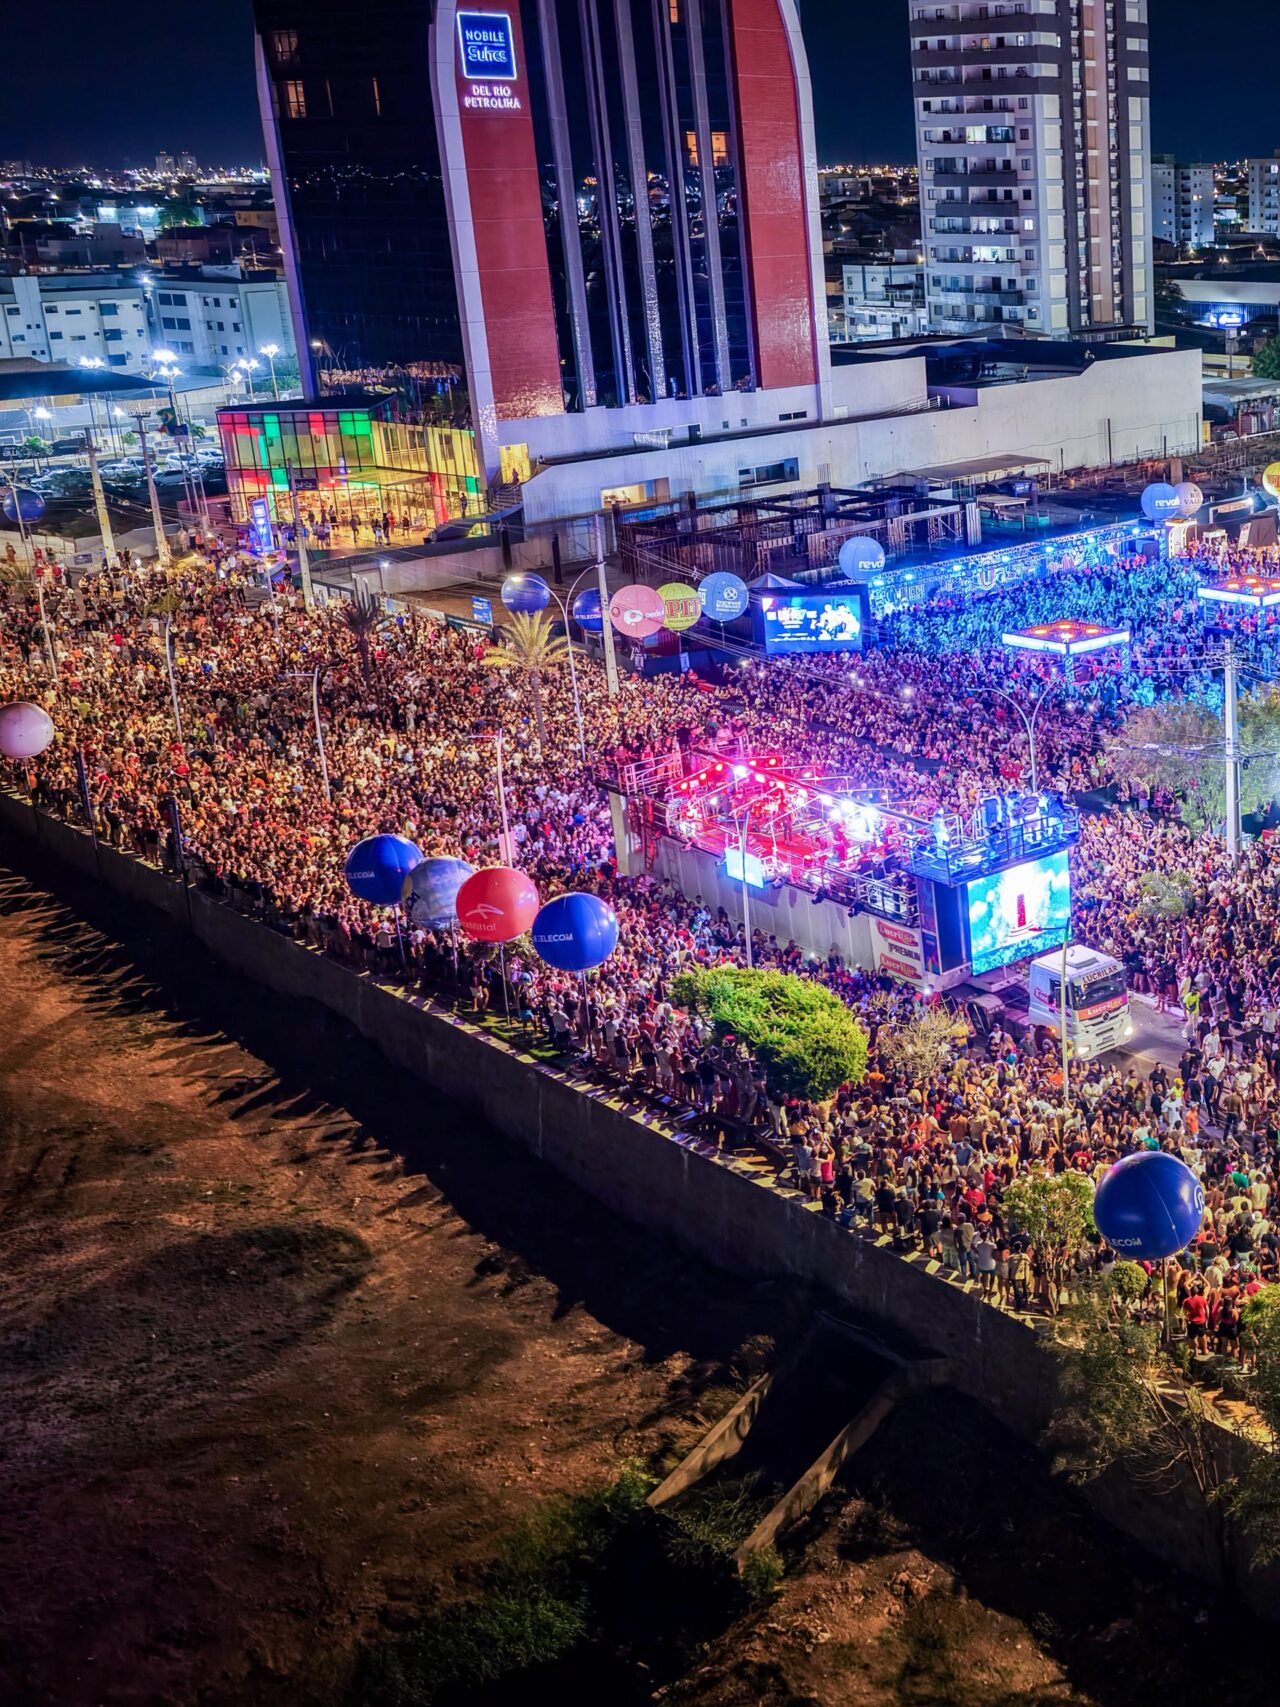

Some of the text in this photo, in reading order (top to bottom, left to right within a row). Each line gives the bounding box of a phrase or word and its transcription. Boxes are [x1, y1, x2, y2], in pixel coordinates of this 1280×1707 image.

[465, 29, 505, 42] NOBILE
[468, 46, 508, 63] Suites
[472, 85, 512, 97] DEL RIO
[464, 96, 521, 109] PETROLINA
[1082, 965, 1119, 983] LUCRILAR
[1087, 998, 1122, 1016] Lucrilar
